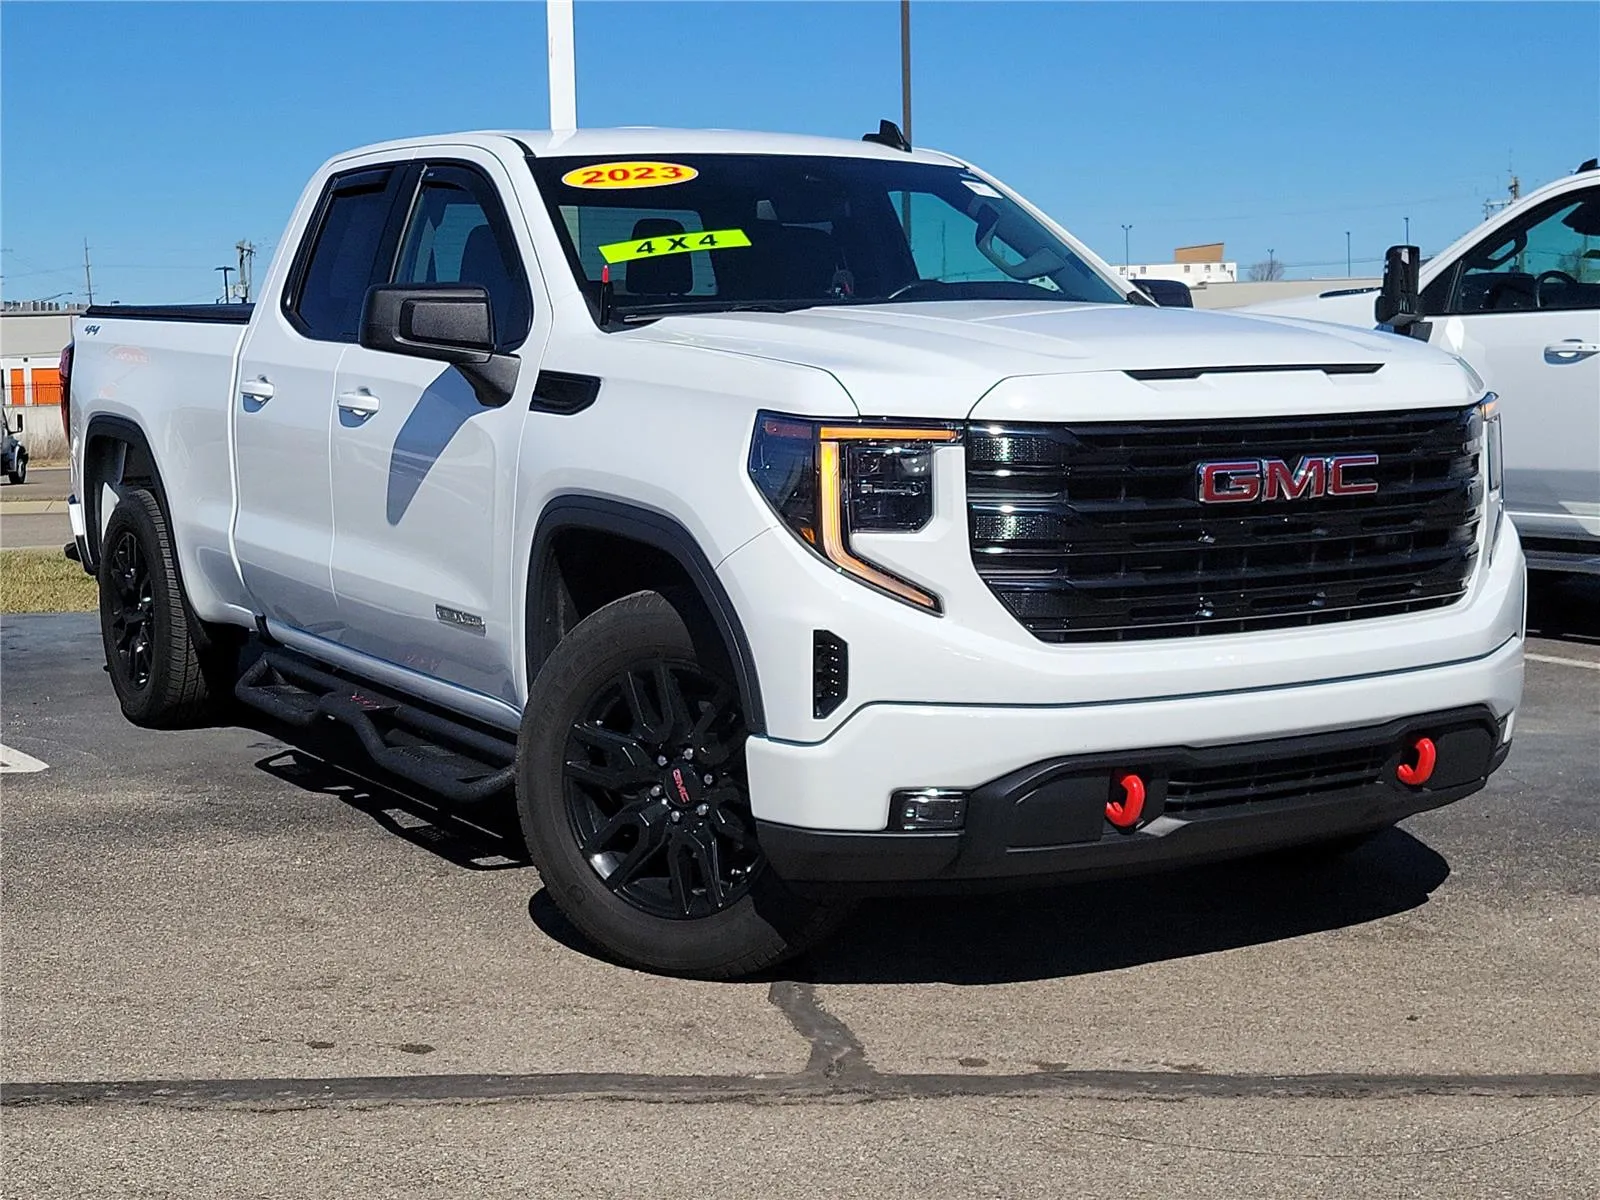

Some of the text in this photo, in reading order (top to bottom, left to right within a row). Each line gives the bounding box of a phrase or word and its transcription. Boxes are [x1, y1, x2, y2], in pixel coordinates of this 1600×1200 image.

[582, 166, 682, 185] 2023
[1196, 455, 1379, 503] GMC
[672, 768, 690, 803] GMC
